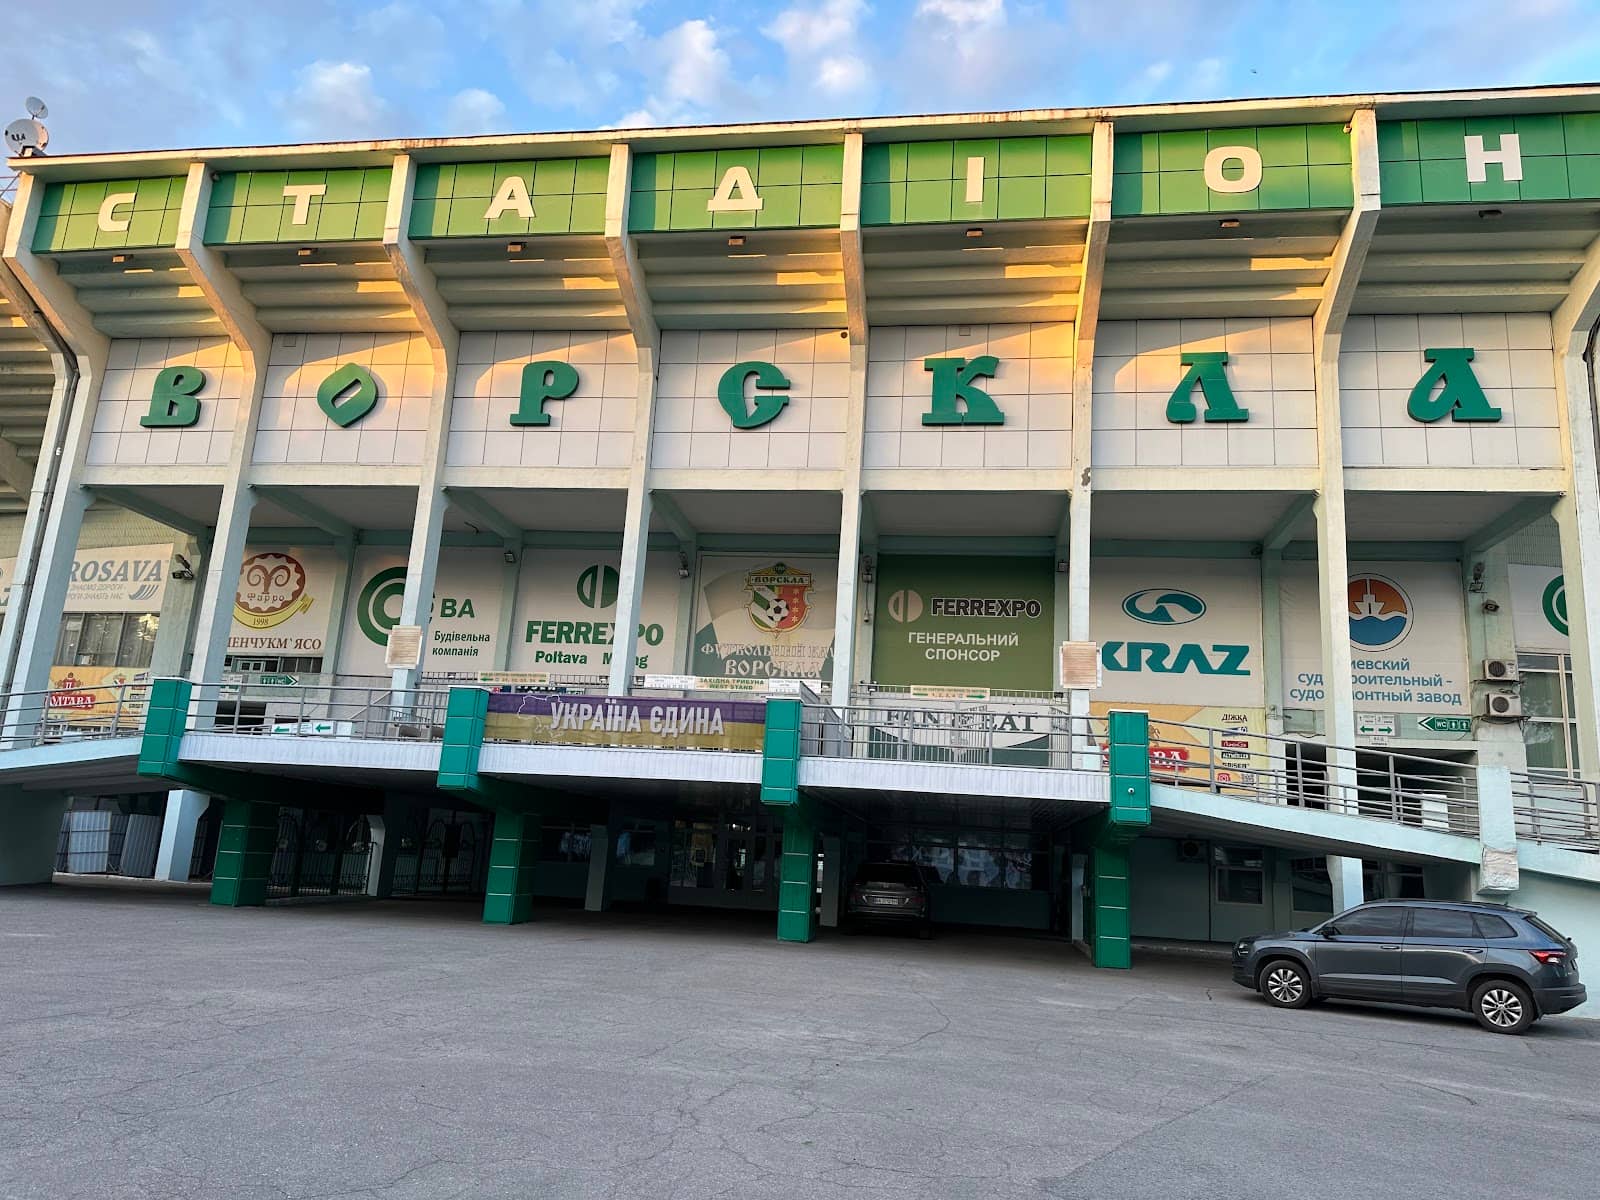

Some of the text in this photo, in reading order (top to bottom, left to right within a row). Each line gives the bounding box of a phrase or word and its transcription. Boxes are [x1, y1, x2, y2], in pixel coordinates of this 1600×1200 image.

[98, 133, 1523, 232] СТАДІОН
[140, 348, 1502, 429] ВОРСКЛА
[931, 598, 1042, 618] FERREXPO
[252, 617, 269, 626] 1998
[434, 631, 490, 643] Будівельна
[908, 632, 1019, 646] ГЕНЕРАЛЬНИЙ
[432, 646, 479, 656] компанія
[535, 651, 588, 664] Poltava
[925, 648, 1001, 661] СПОНСОР
[1102, 641, 1251, 676] KRAZ
[725, 659, 821, 677] ВОРСКЛА
[1416, 692, 1462, 705] завод
[551, 699, 725, 738] УКРАЇНА ЄДИНА
[1436, 720, 1447, 728] WC
